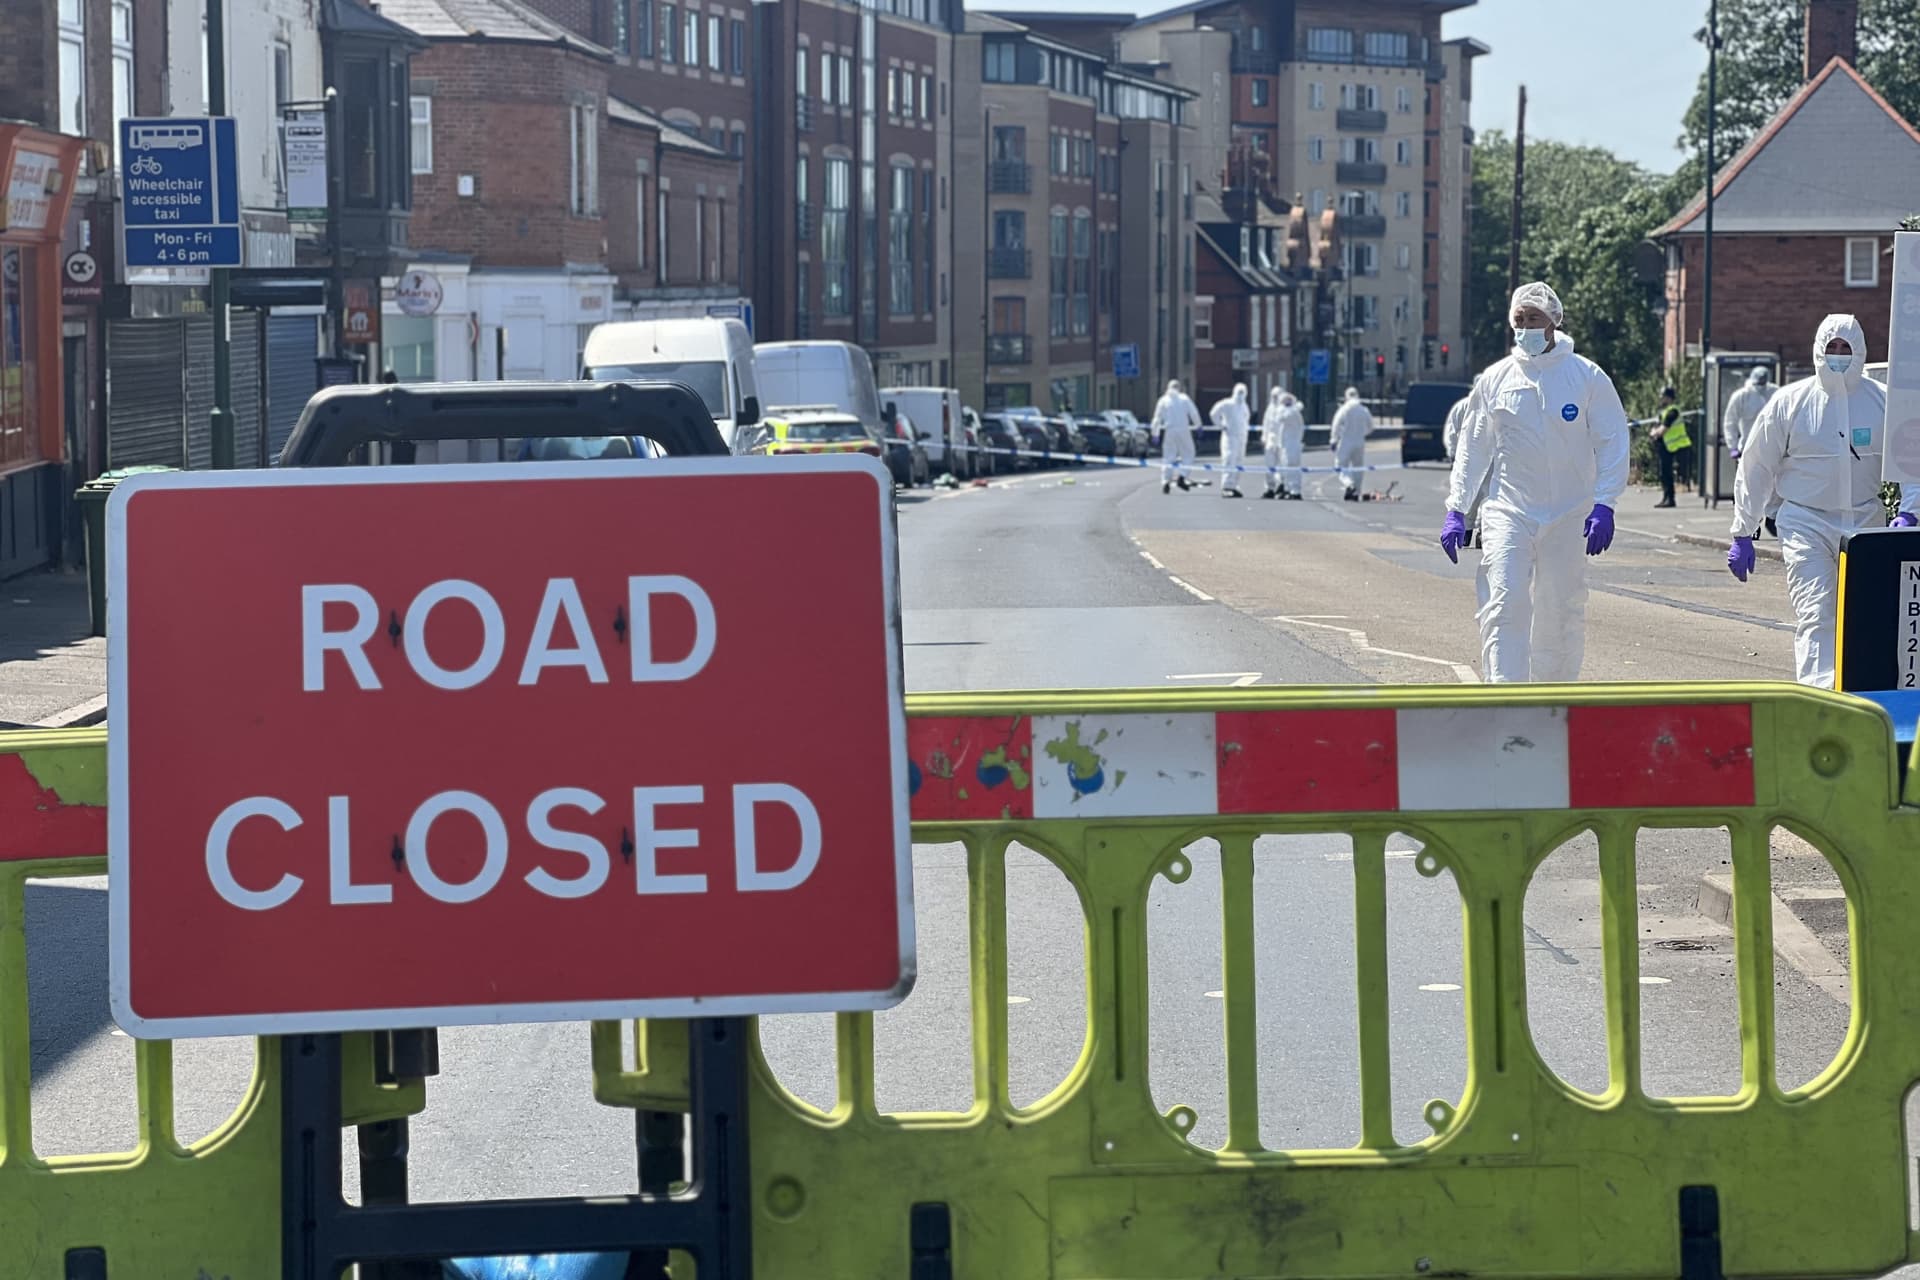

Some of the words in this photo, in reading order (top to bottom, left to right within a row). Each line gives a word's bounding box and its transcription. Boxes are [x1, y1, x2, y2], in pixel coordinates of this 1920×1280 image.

[129, 178, 204, 191] Wheelchair
[132, 193, 202, 206] accessible
[154, 208, 180, 220] taxi
[154, 232, 184, 245] Mon
[194, 232, 212, 244] Fri
[157, 249, 167, 260] 4
[177, 248, 187, 261] 6
[189, 251, 210, 263] pm
[301, 574, 717, 692] ROAD
[205, 782, 822, 911] CLOSED
